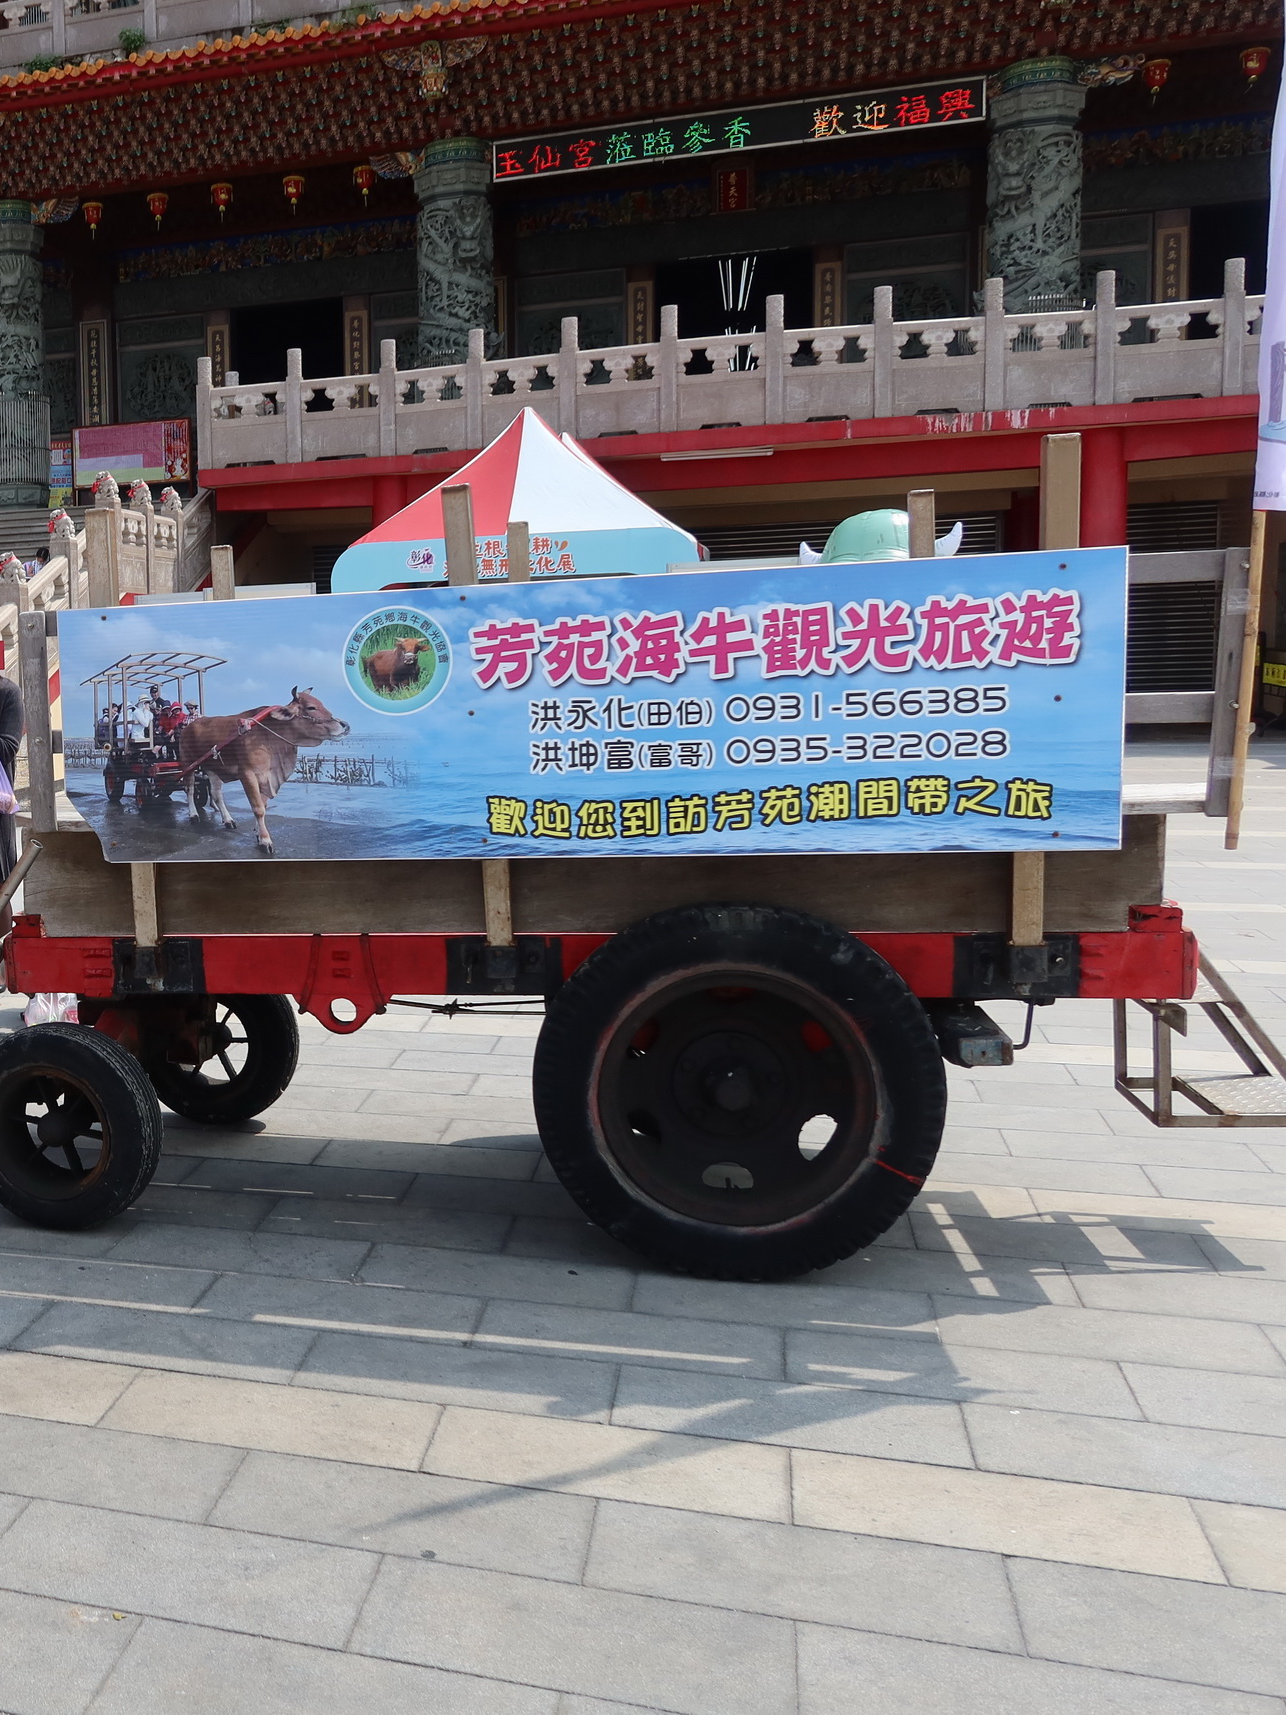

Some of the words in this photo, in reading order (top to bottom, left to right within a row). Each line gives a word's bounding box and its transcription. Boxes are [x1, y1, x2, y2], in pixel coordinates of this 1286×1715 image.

[808, 88, 976, 138] 歡迎福興
[345, 611, 450, 668] 彰化縣芳苑鄉海牛觀光協會
[470, 590, 1077, 687] 芳苑海牛觀光旅遊
[530, 696, 713, 733] 洪永化(田伯)
[725, 686, 1007, 722] 0931-566385
[531, 739, 714, 774] 洪坤富(富哥)
[725, 730, 1008, 764] 0935-322028
[487, 776, 1053, 839] 歡迎您到訪芳苑潮間帶之旅
